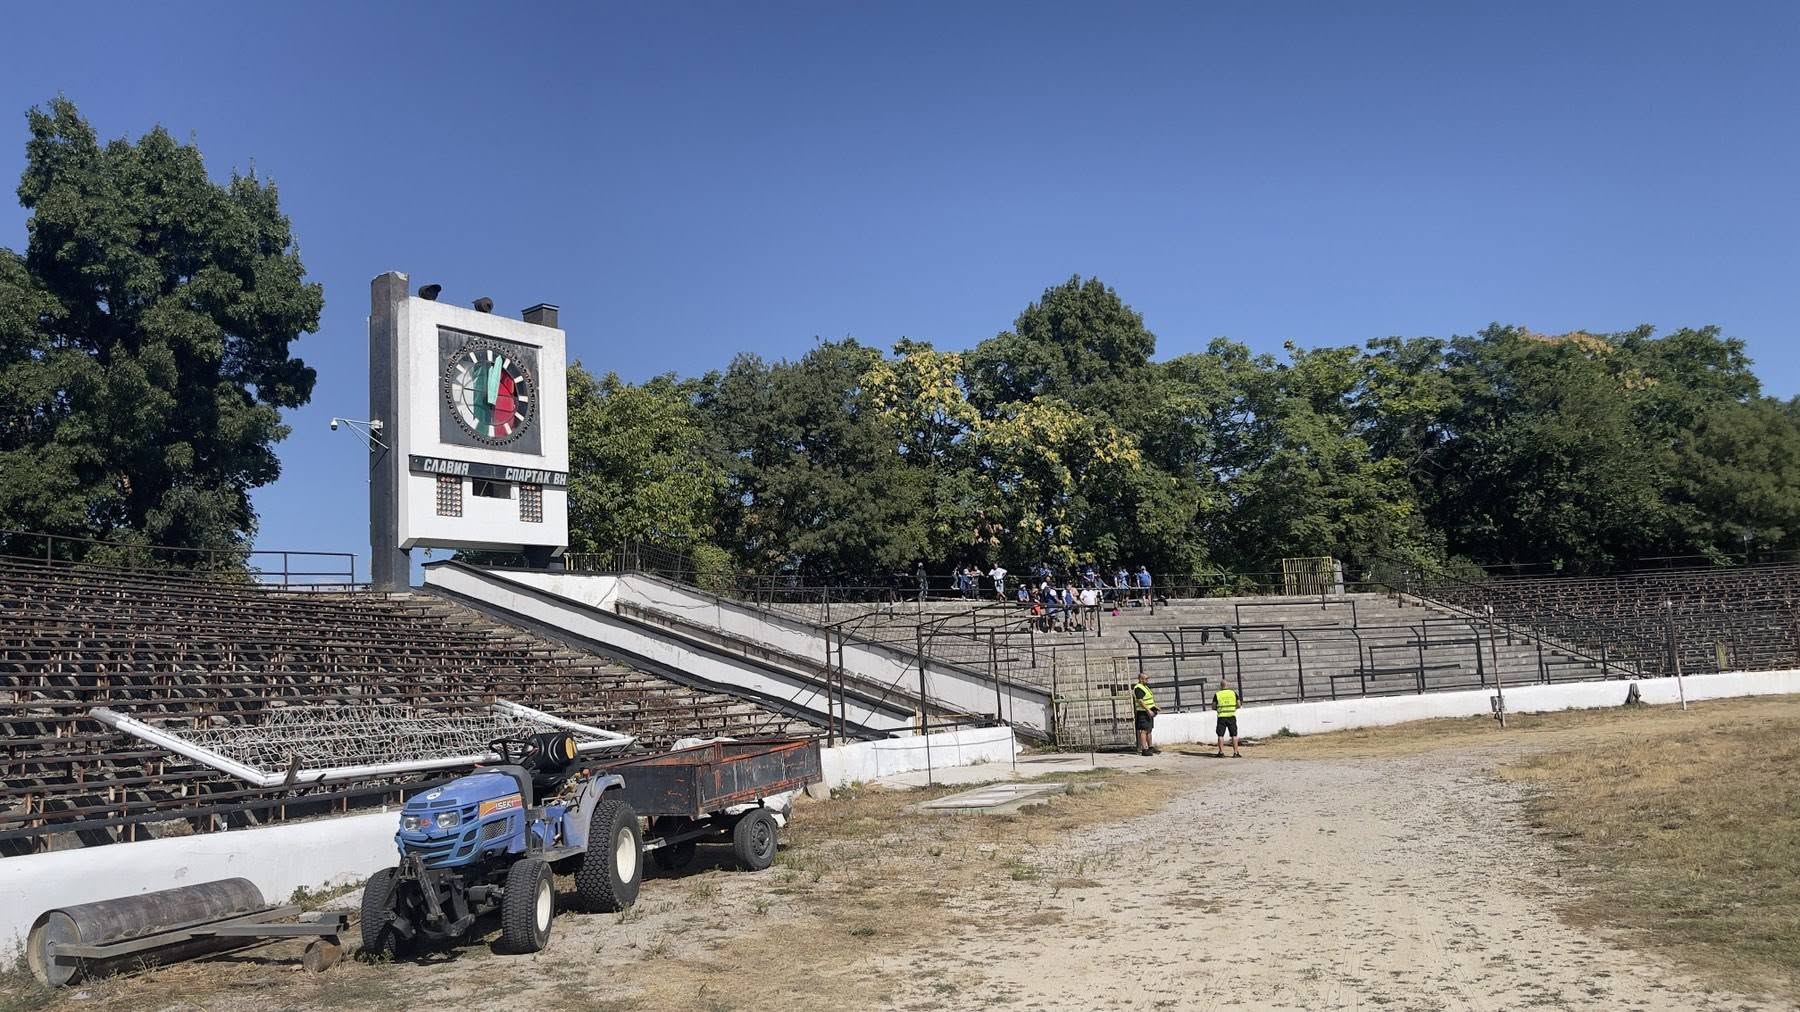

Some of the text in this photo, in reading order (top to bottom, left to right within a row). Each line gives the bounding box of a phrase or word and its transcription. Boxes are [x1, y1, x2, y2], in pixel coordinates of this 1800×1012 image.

[423, 458, 470, 476] СЛАВИЯ
[505, 467, 567, 486] СПАРТАК ВН
